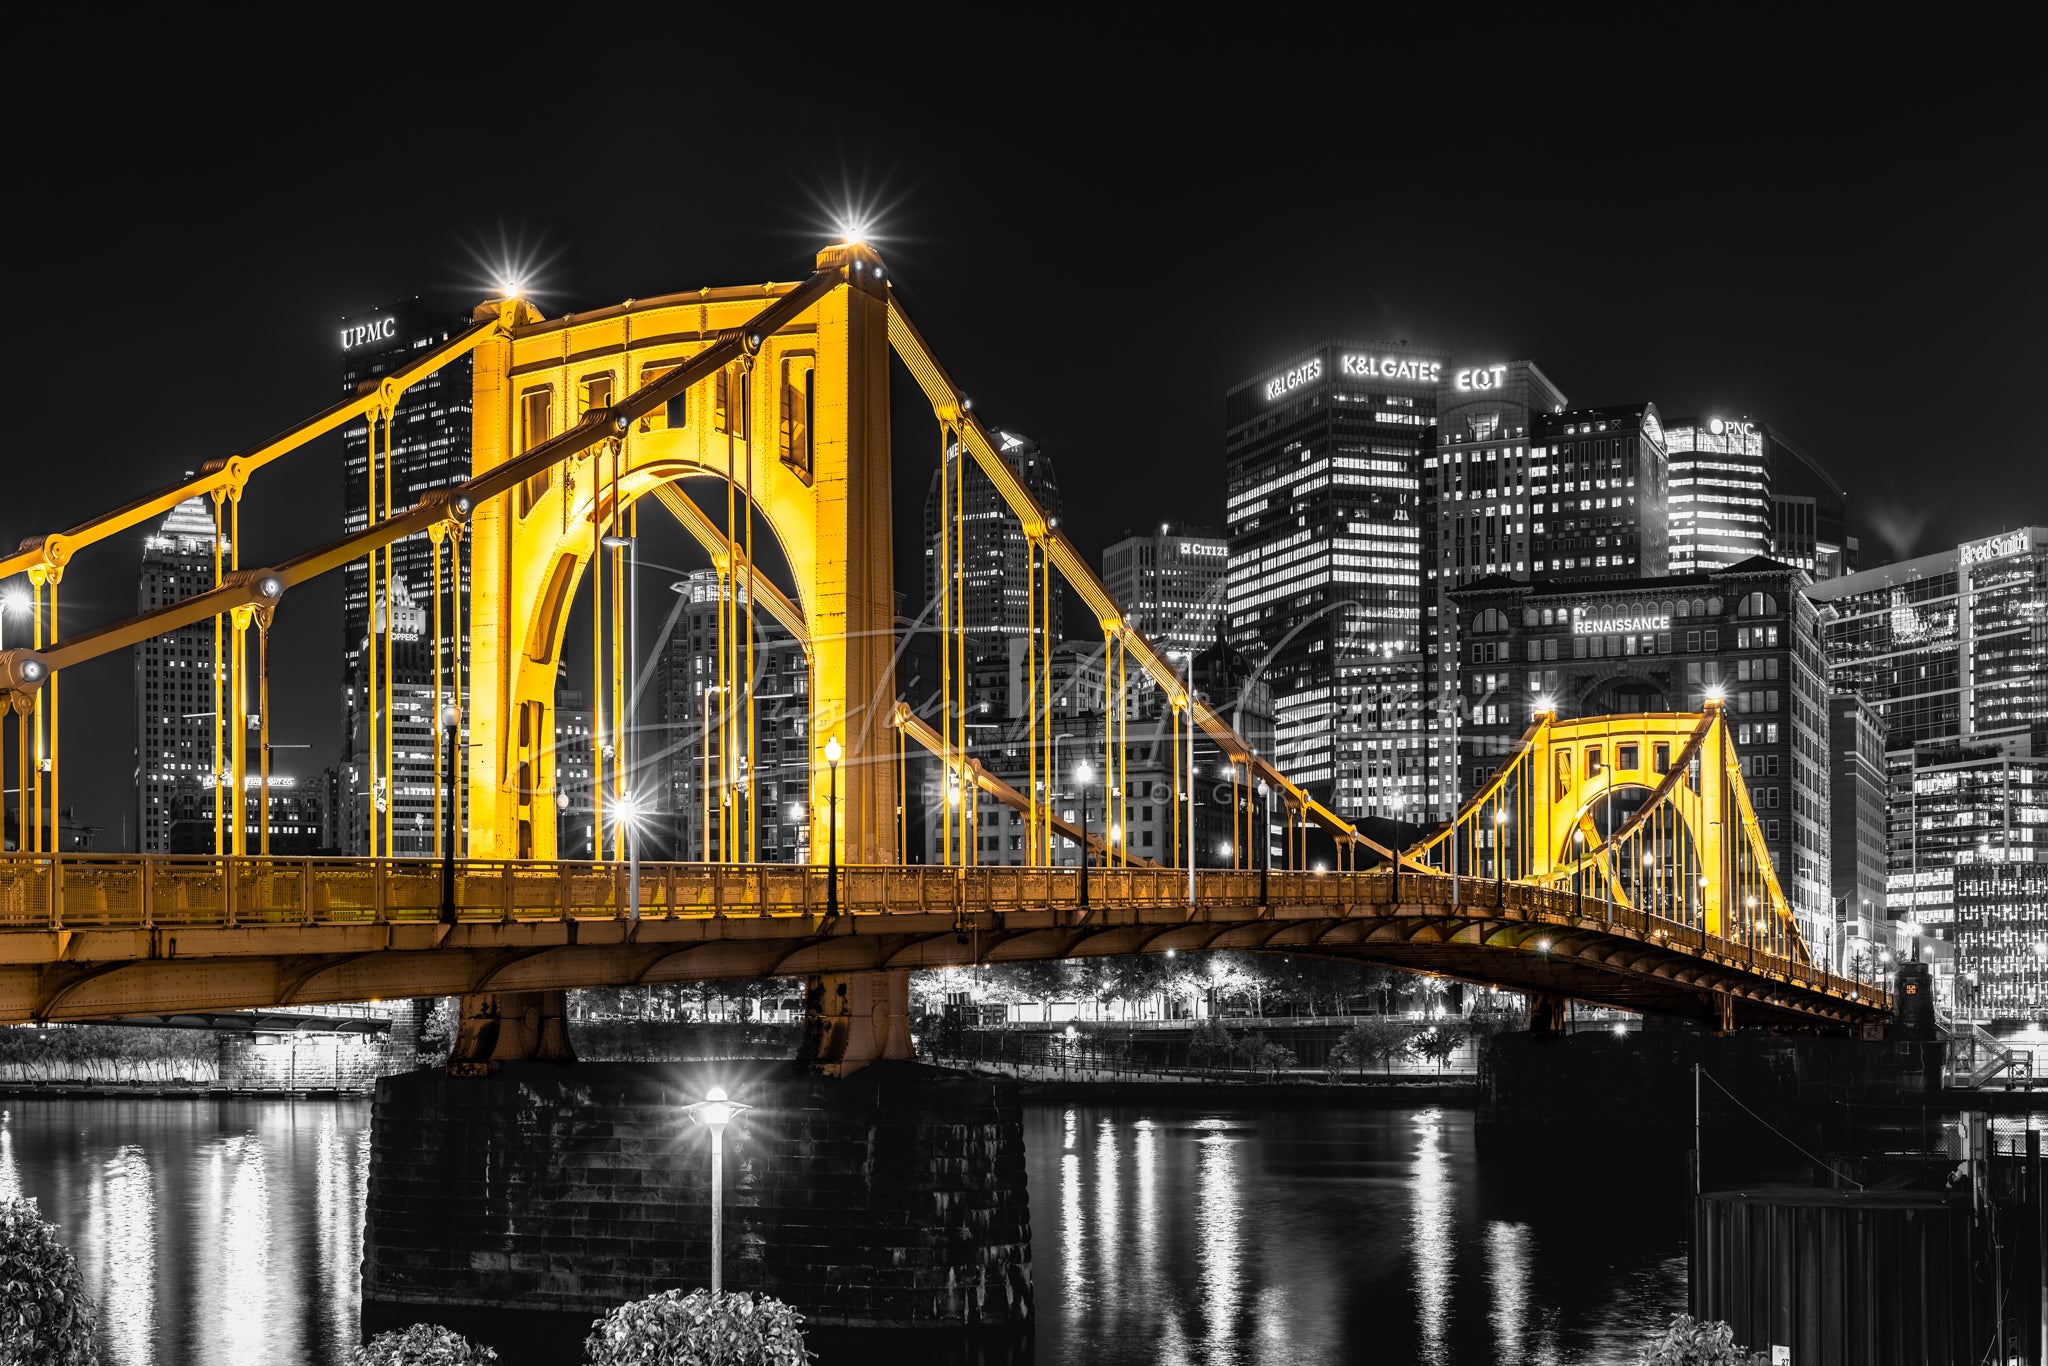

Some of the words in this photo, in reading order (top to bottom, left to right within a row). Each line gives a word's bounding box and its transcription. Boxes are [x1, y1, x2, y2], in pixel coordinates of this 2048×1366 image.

[340, 317, 395, 349] UPMC
[1267, 374, 1287, 401] K&L
[1286, 359, 1321, 390] GATES
[1342, 354, 1379, 376] K&L
[1380, 359, 1441, 382] GATES
[1456, 365, 1507, 391] EQT
[1724, 420, 1755, 436] PNC
[1959, 540, 1991, 566] Reed
[1990, 532, 2029, 557] Smith
[1574, 616, 1670, 634] RENAISSANCE
